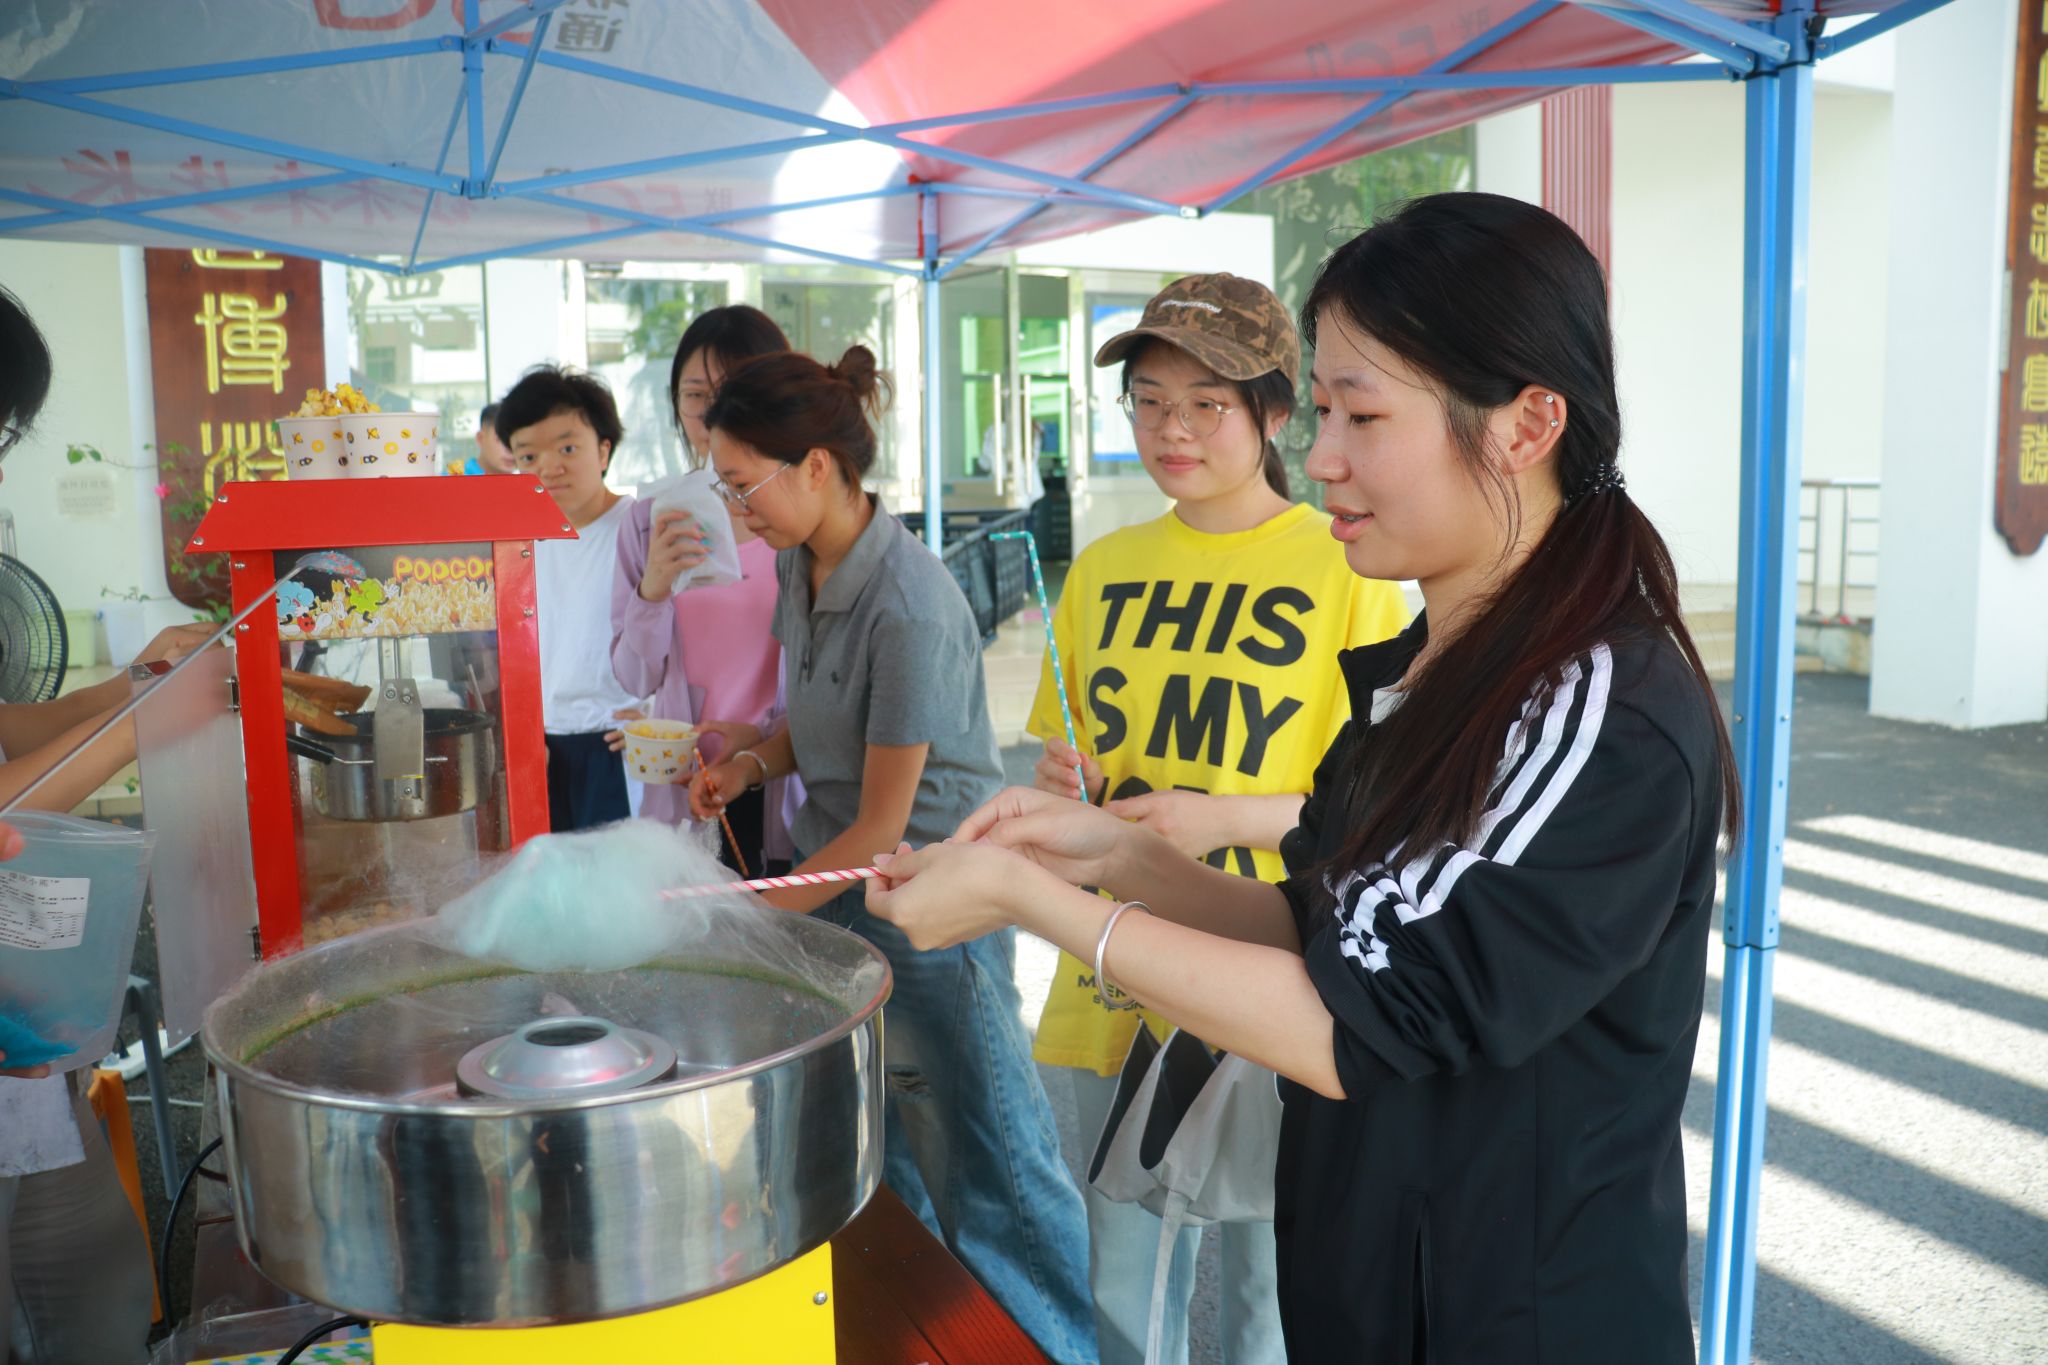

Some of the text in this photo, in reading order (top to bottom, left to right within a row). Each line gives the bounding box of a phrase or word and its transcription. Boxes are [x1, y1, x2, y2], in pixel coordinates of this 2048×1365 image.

[1098, 580, 1316, 667] THIS
[1084, 666, 1304, 778] S MY
